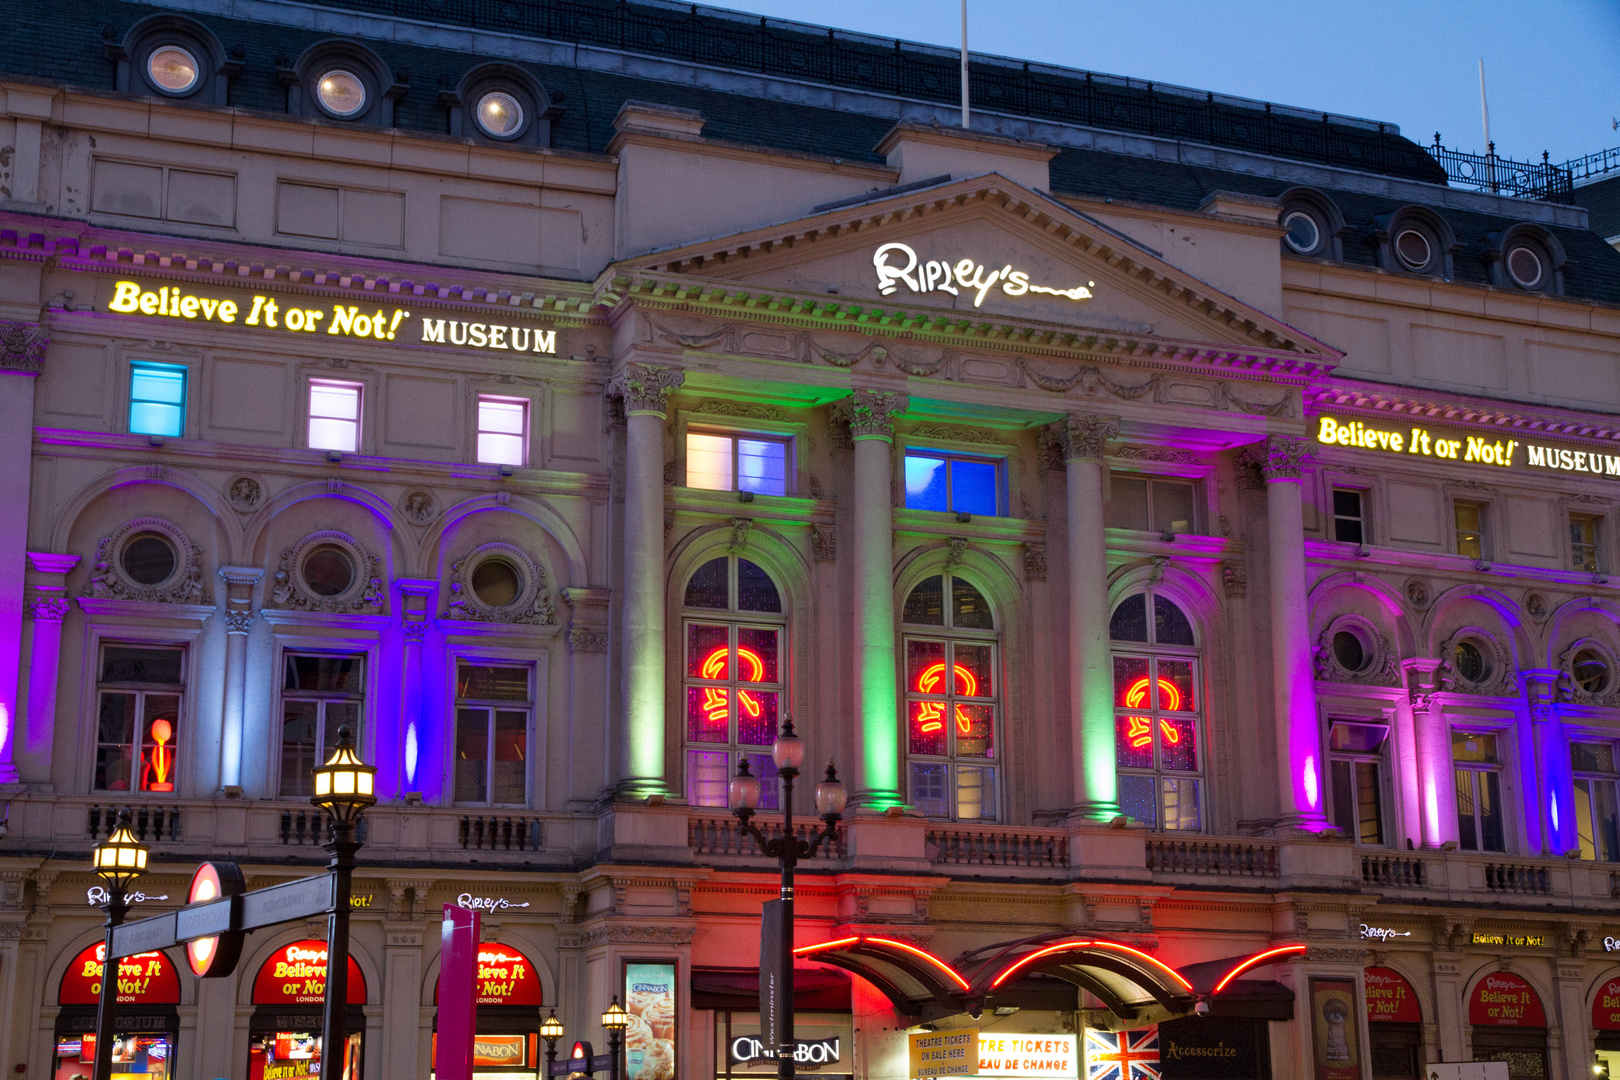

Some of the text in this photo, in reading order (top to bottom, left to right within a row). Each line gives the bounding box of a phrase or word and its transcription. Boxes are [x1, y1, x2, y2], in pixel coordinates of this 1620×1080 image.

[109, 281, 557, 353] Believe It or Not! MUSEUM
[1317, 416, 1403, 451] Believe
[1409, 428, 1431, 455] It
[1435, 438, 1461, 459] or
[1464, 436, 1513, 466] Not!
[178, 908, 230, 932] UNDERGROUND
[1472, 932, 1545, 947] Believe It or Not!
[82, 961, 162, 977] Beeve It
[511, 965, 525, 980] It
[283, 983, 301, 994] or
[482, 980, 515, 996] Not!
[1365, 986, 1406, 999] elieve It
[1480, 990, 1530, 1004] Believe It
[1375, 1000, 1399, 1014] Not!
[1488, 1006, 1524, 1018] or Not!
[916, 1036, 943, 1049] THEATRE
[944, 1034, 971, 1046] TICKETS
[1012, 1040, 1070, 1054] TICKETS
[921, 1048, 965, 1061] ON SALE HERE
[1166, 1040, 1237, 1060] Accessorize
[918, 1064, 969, 1077] BUREAU DE CHANGE
[1005, 1059, 1019, 1070] DE
[1023, 1060, 1068, 1071] CHANGE
